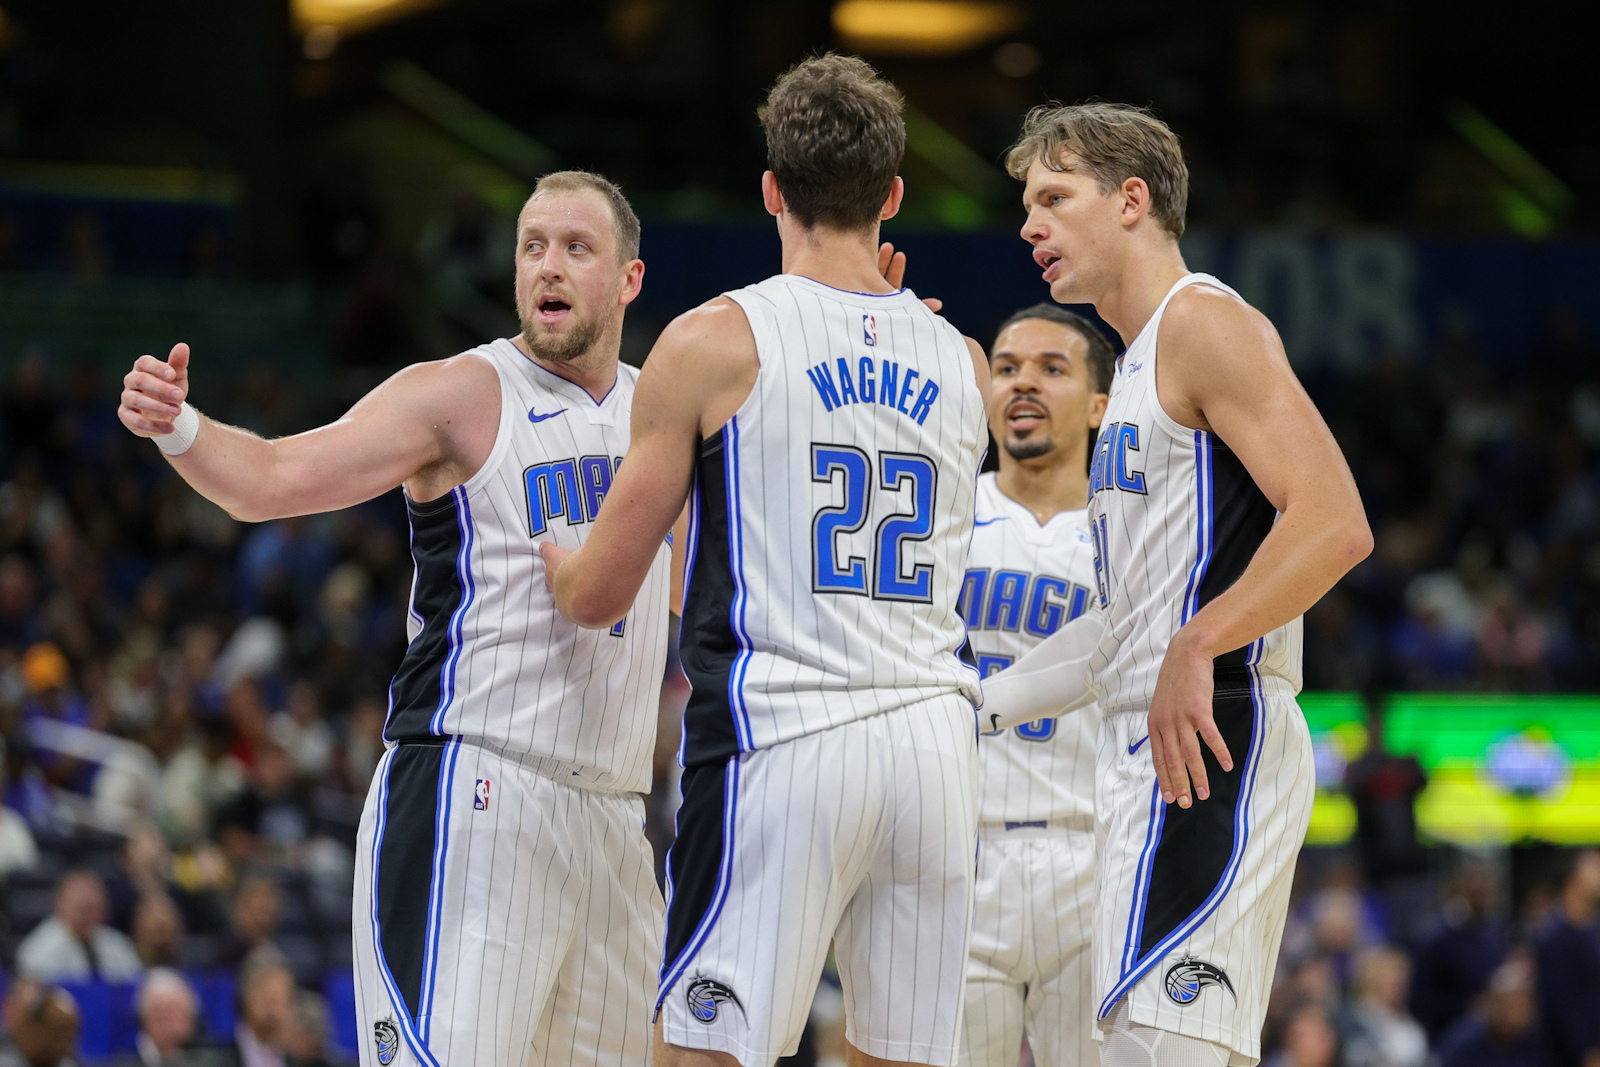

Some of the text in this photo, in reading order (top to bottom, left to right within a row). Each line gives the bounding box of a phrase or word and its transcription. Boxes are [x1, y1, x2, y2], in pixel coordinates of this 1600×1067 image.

[807, 356, 940, 426] WAGNER
[522, 454, 625, 539] MA
[811, 442, 938, 605] 22
